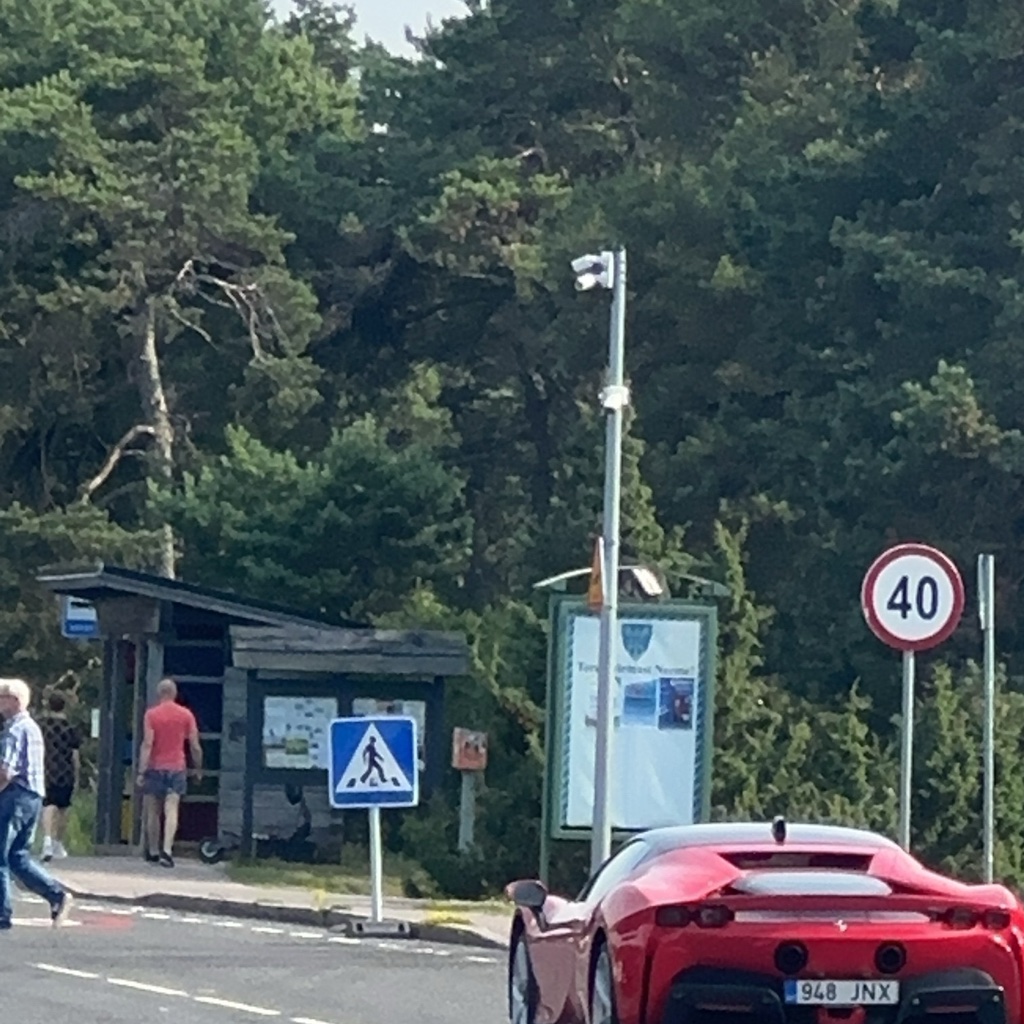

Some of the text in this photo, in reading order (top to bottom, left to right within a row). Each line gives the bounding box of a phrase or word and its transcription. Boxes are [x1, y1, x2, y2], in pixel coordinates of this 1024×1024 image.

[887, 575, 939, 620] 40
[801, 982, 891, 1001] 948 JNX
